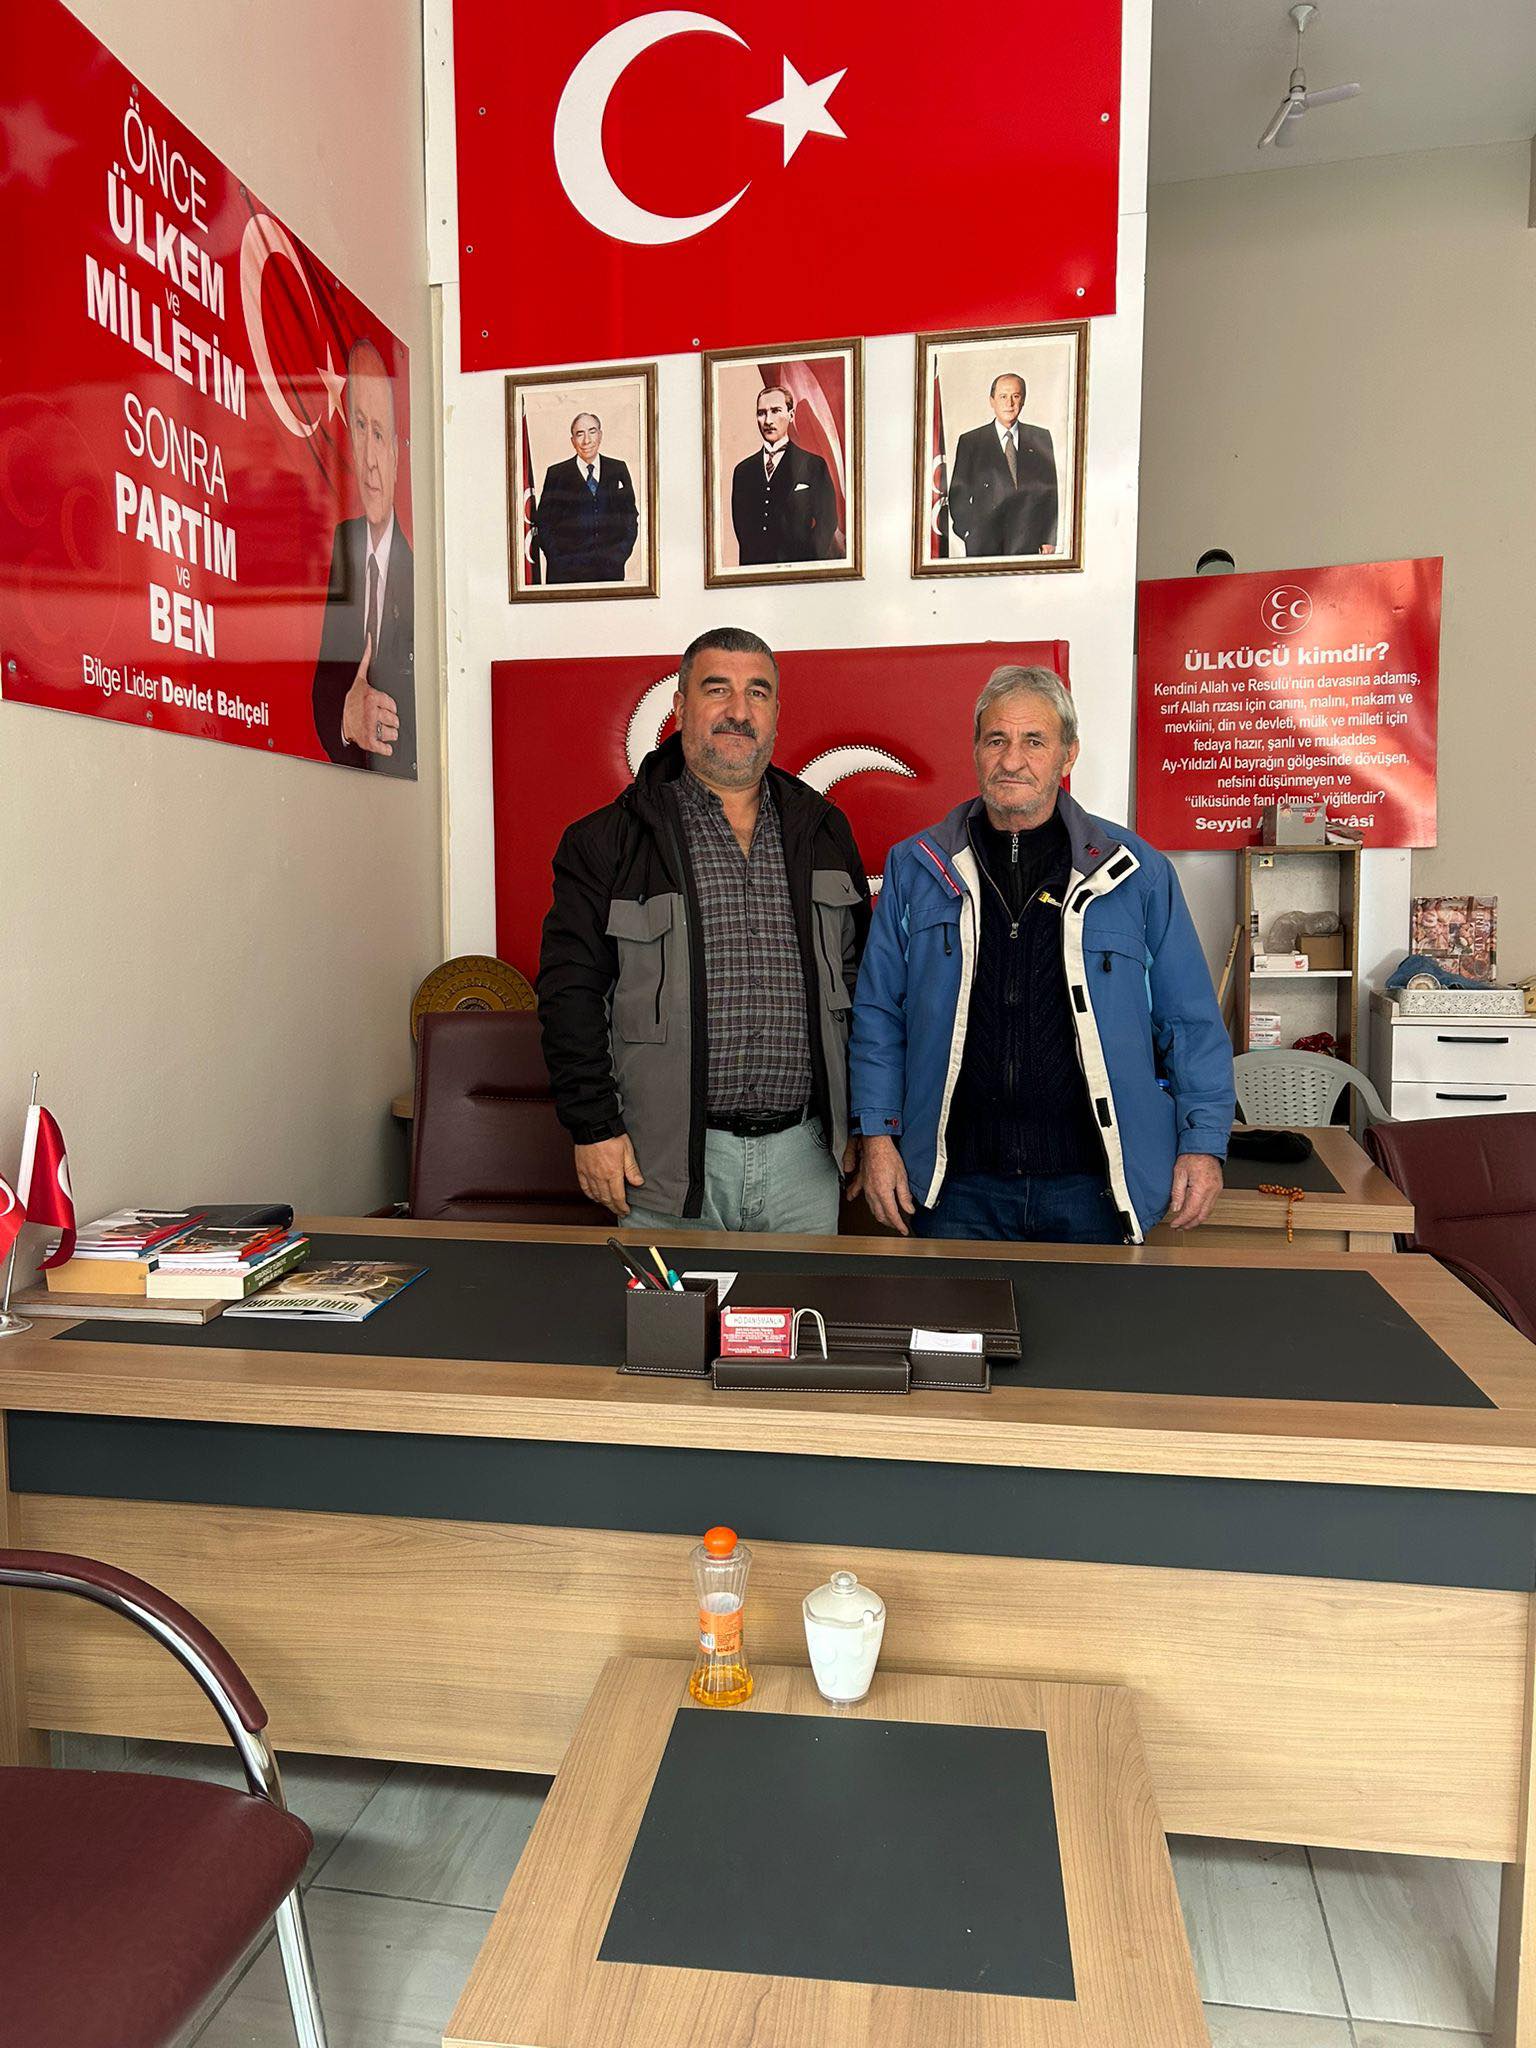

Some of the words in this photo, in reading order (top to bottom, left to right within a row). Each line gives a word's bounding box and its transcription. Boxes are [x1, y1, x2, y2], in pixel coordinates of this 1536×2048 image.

[124, 95, 208, 234] ÖNCE
[108, 161, 225, 320] ÜLKEM
[165, 287, 181, 317] ve
[86, 254, 247, 421] MİLLETİM
[124, 392, 229, 504] SONRA
[115, 471, 237, 582] PARTİM
[175, 564, 191, 589] ve
[149, 582, 215, 659] BEN
[1185, 644, 1290, 671] ÜLKÜCÜ
[1298, 641, 1390, 665] kimdir?
[83, 654, 122, 697] Bilge
[124, 665, 160, 701] Lider
[161, 675, 214, 714] Devlet
[217, 690, 269, 729] Bahçeli
[1154, 682, 1198, 696] Kendini
[1200, 680, 1229, 694] Allah
[1231, 681, 1246, 693] ve
[1248, 676, 1315, 692] Resulü'nün
[1317, 674, 1371, 688] davasına
[1373, 671, 1421, 687] adamış,
[1160, 700, 1179, 715] sırf
[1181, 700, 1210, 714] Allah
[1245, 698, 1266, 714] için
[1268, 696, 1308, 711] canını,
[1310, 694, 1349, 708] malını,
[1351, 692, 1396, 707] makam
[1398, 693, 1413, 704] ve
[1165, 719, 1215, 734] mevkiini,
[1217, 717, 1236, 732] din
[1238, 718, 1253, 730] ve
[1255, 714, 1297, 731] devleti,
[1299, 712, 1329, 729] mülk
[1331, 714, 1346, 727] ve
[1348, 711, 1384, 726] milleti
[1385, 710, 1408, 727] için
[1193, 738, 1232, 754] fedaya
[1234, 736, 1265, 752] hazır,
[1267, 735, 1295, 752] şanlı
[1297, 736, 1313, 749] ve
[1314, 733, 1377, 748] mukaddes
[1161, 757, 1217, 775] Ay-Yıldızlı
[1219, 756, 1232, 769] Al
[1234, 754, 1285, 772] bayrağın
[1287, 752, 1353, 771] gölgesinde
[1354, 750, 1410, 768] dövüşen,
[1217, 774, 1256, 789] nefsini
[1258, 772, 1335, 790] düşünmeyen
[1336, 774, 1352, 786] ve
[1253, 793, 1275, 807] fani
[1195, 816, 1252, 833] Seyyid
